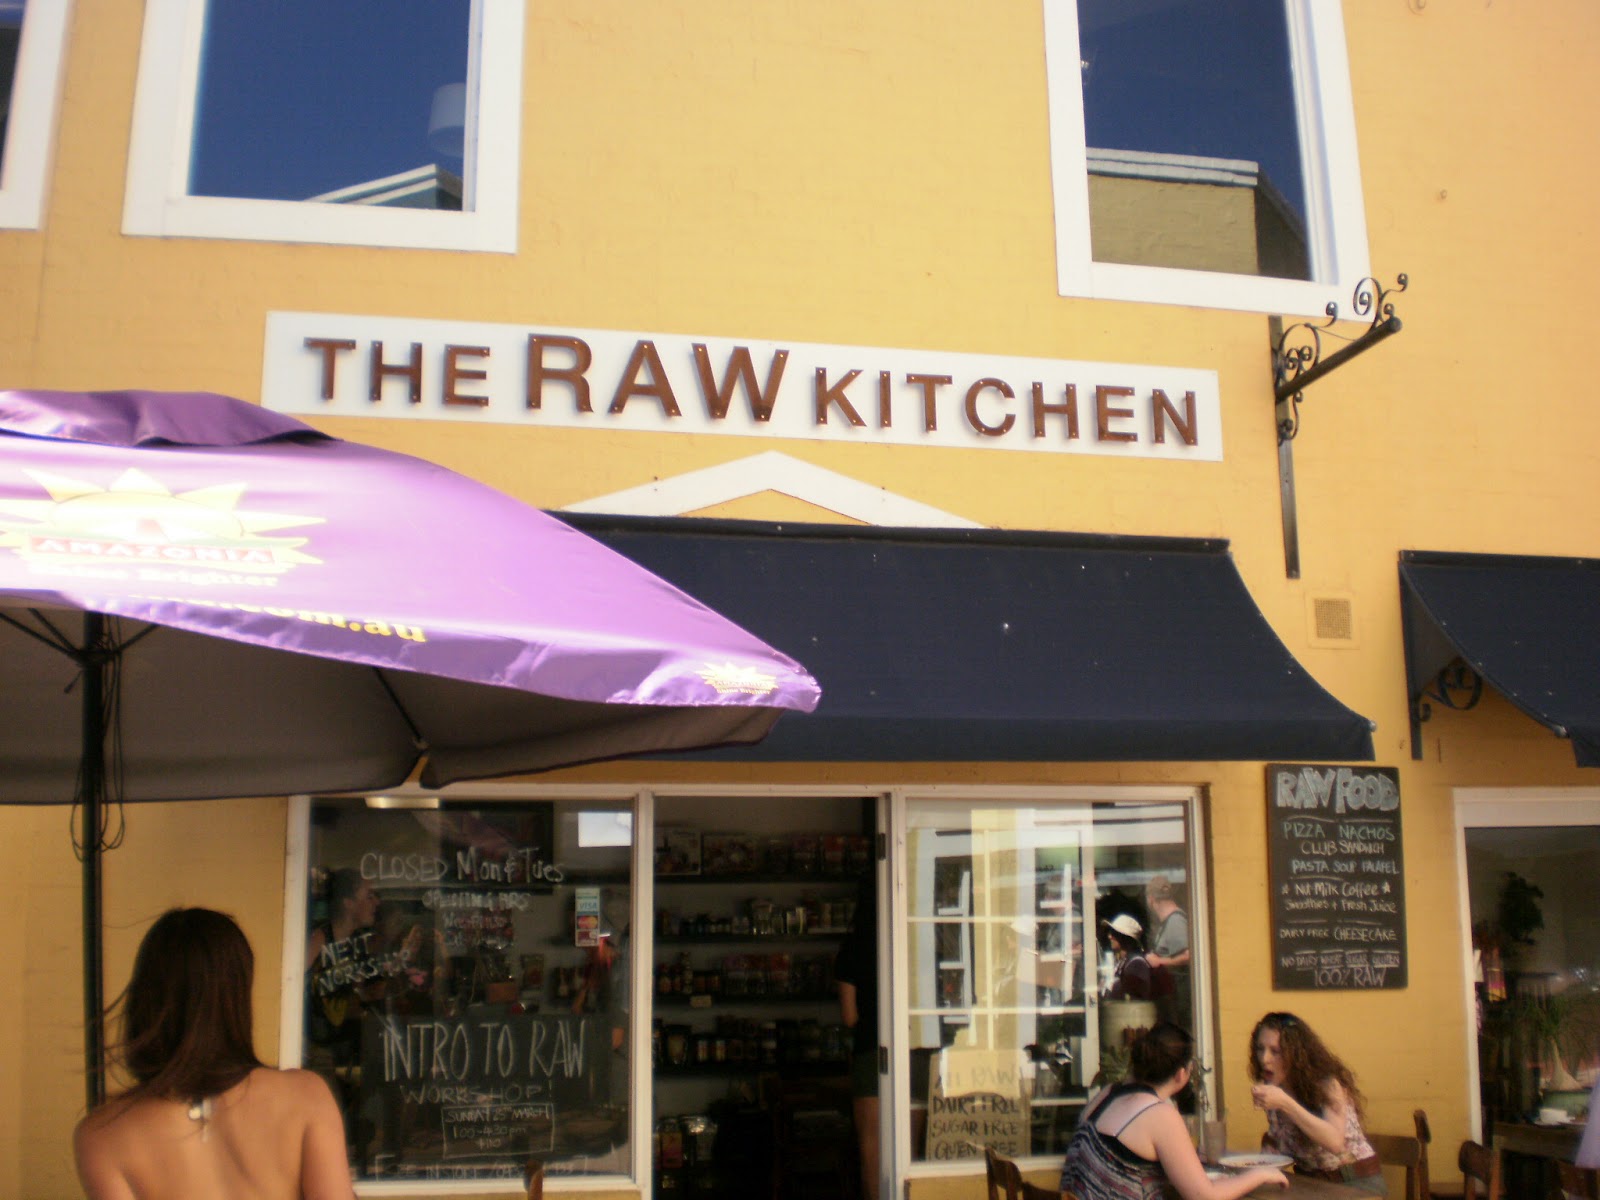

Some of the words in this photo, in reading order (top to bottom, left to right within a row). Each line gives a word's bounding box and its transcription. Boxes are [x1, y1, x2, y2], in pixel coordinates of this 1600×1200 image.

[303, 337, 490, 406] THE
[527, 333, 790, 422] RAW
[815, 367, 1198, 446] KITCHEN
[36, 538, 272, 563] AMAZONIA
[1277, 767, 1336, 809] RAW
[1336, 767, 1400, 813] FOOD
[1283, 821, 1325, 839] PIZZA
[1338, 824, 1395, 842] NACHOS
[1301, 840, 1338, 856] CLUB
[360, 852, 448, 882] CLOSED
[456, 846, 503, 882] Mon
[517, 847, 566, 884] Tues
[1291, 859, 1329, 874] PASTA
[1333, 860, 1357, 873] SOUP
[1361, 860, 1399, 874] FALAFEL
[1342, 881, 1380, 898] Coffee
[1369, 900, 1397, 913] Juice
[1333, 927, 1398, 942] CHEESECAKE
[1353, 966, 1388, 988] RAW
[384, 1020, 470, 1082] INTRO
[479, 1022, 514, 1077] TO
[529, 1020, 585, 1078] RAW
[932, 1121, 977, 1138] SUGAR
